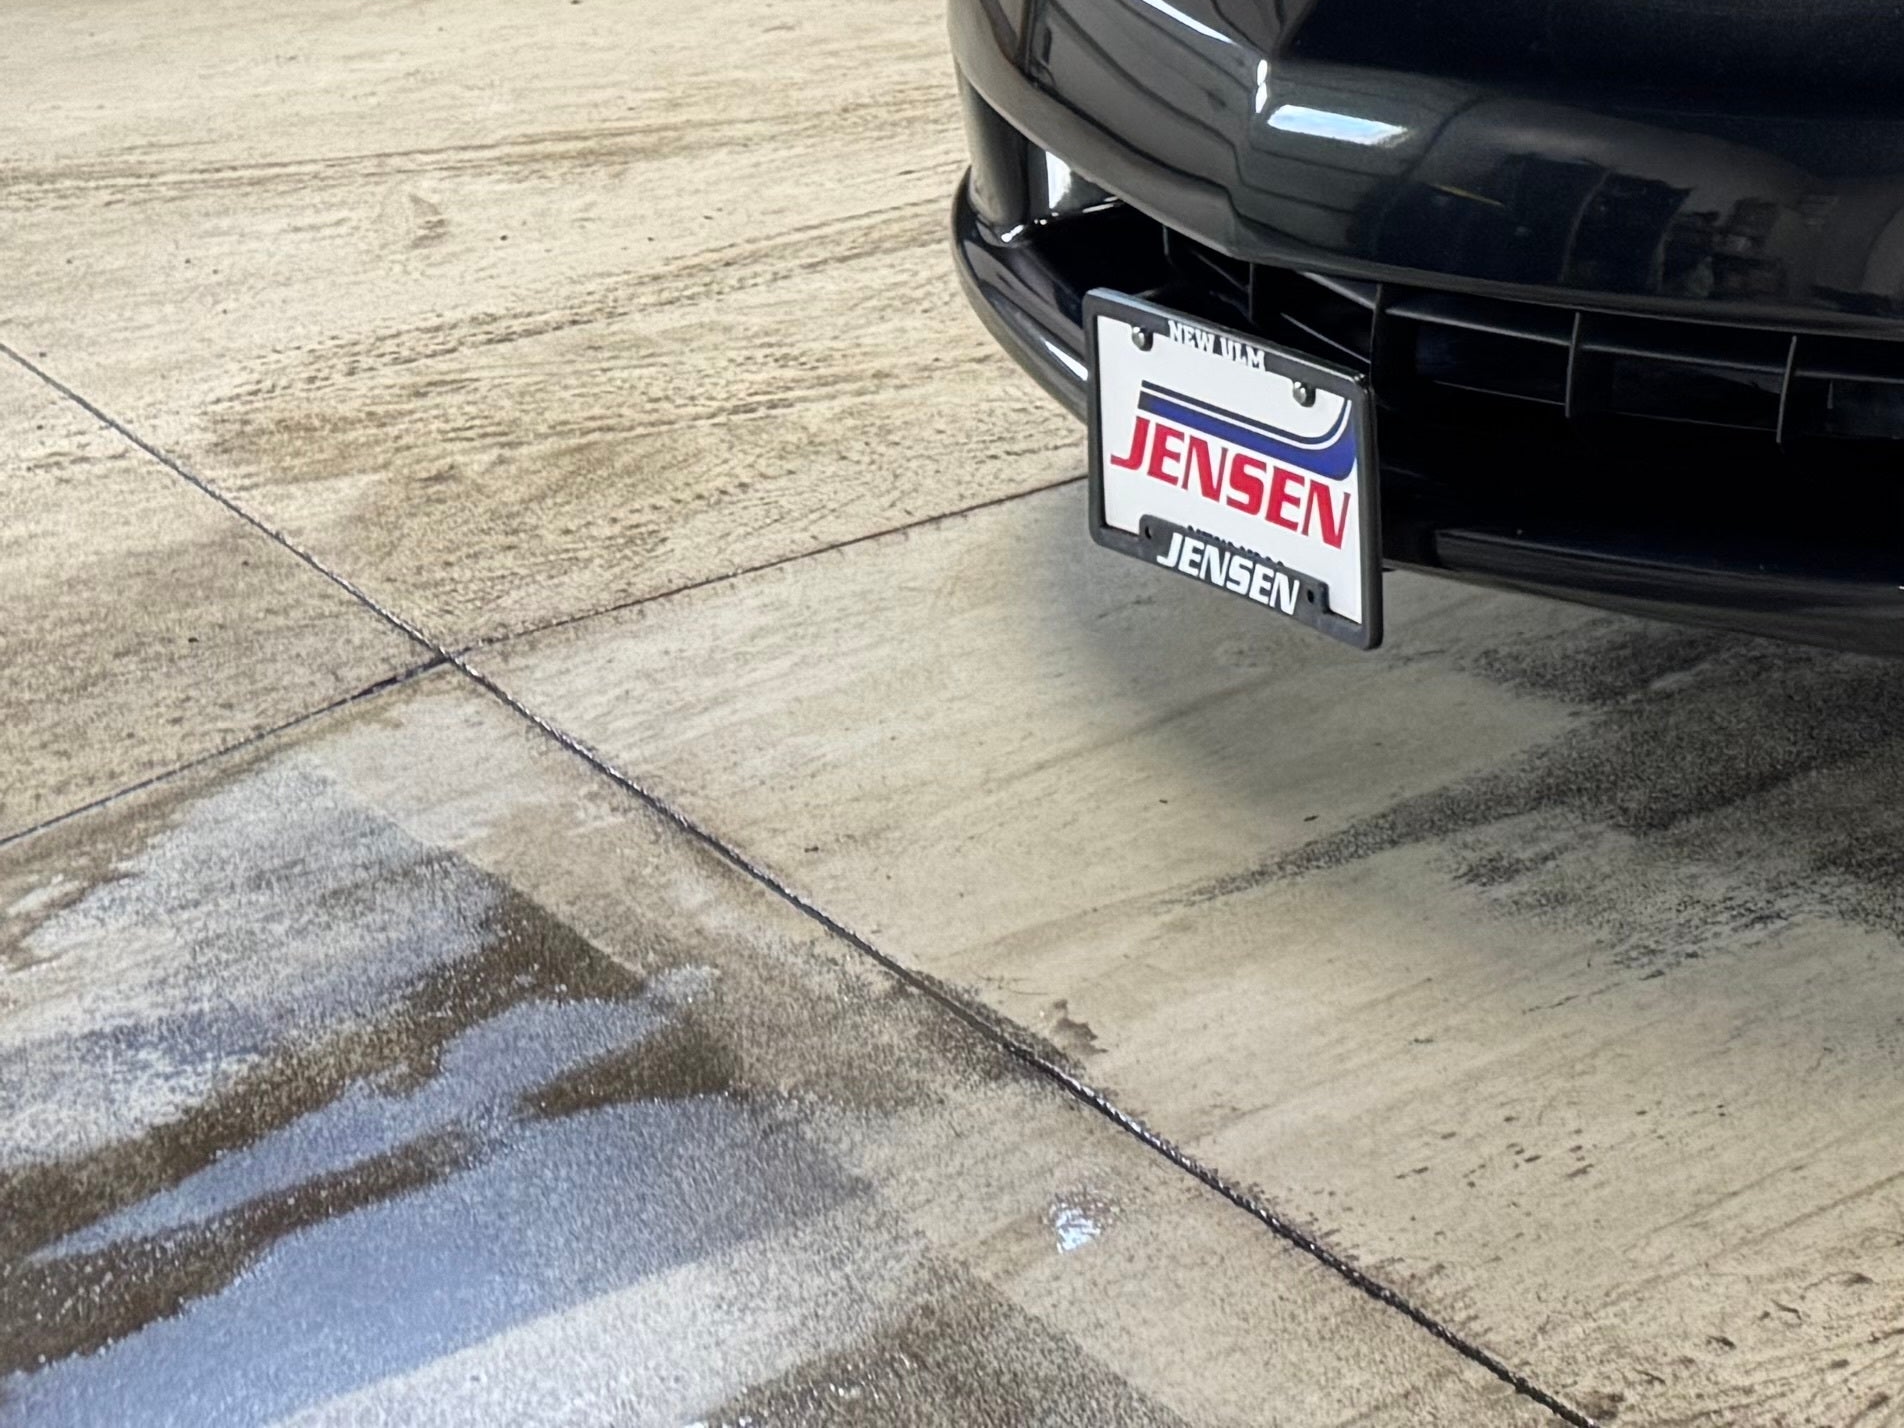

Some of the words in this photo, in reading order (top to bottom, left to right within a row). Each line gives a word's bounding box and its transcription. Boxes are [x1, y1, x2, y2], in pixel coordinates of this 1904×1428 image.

[1168, 320, 1216, 354] NEW
[1220, 337, 1266, 372] ULM
[1110, 416, 1352, 550] JENSEN
[1155, 531, 1301, 616] JENSEN
